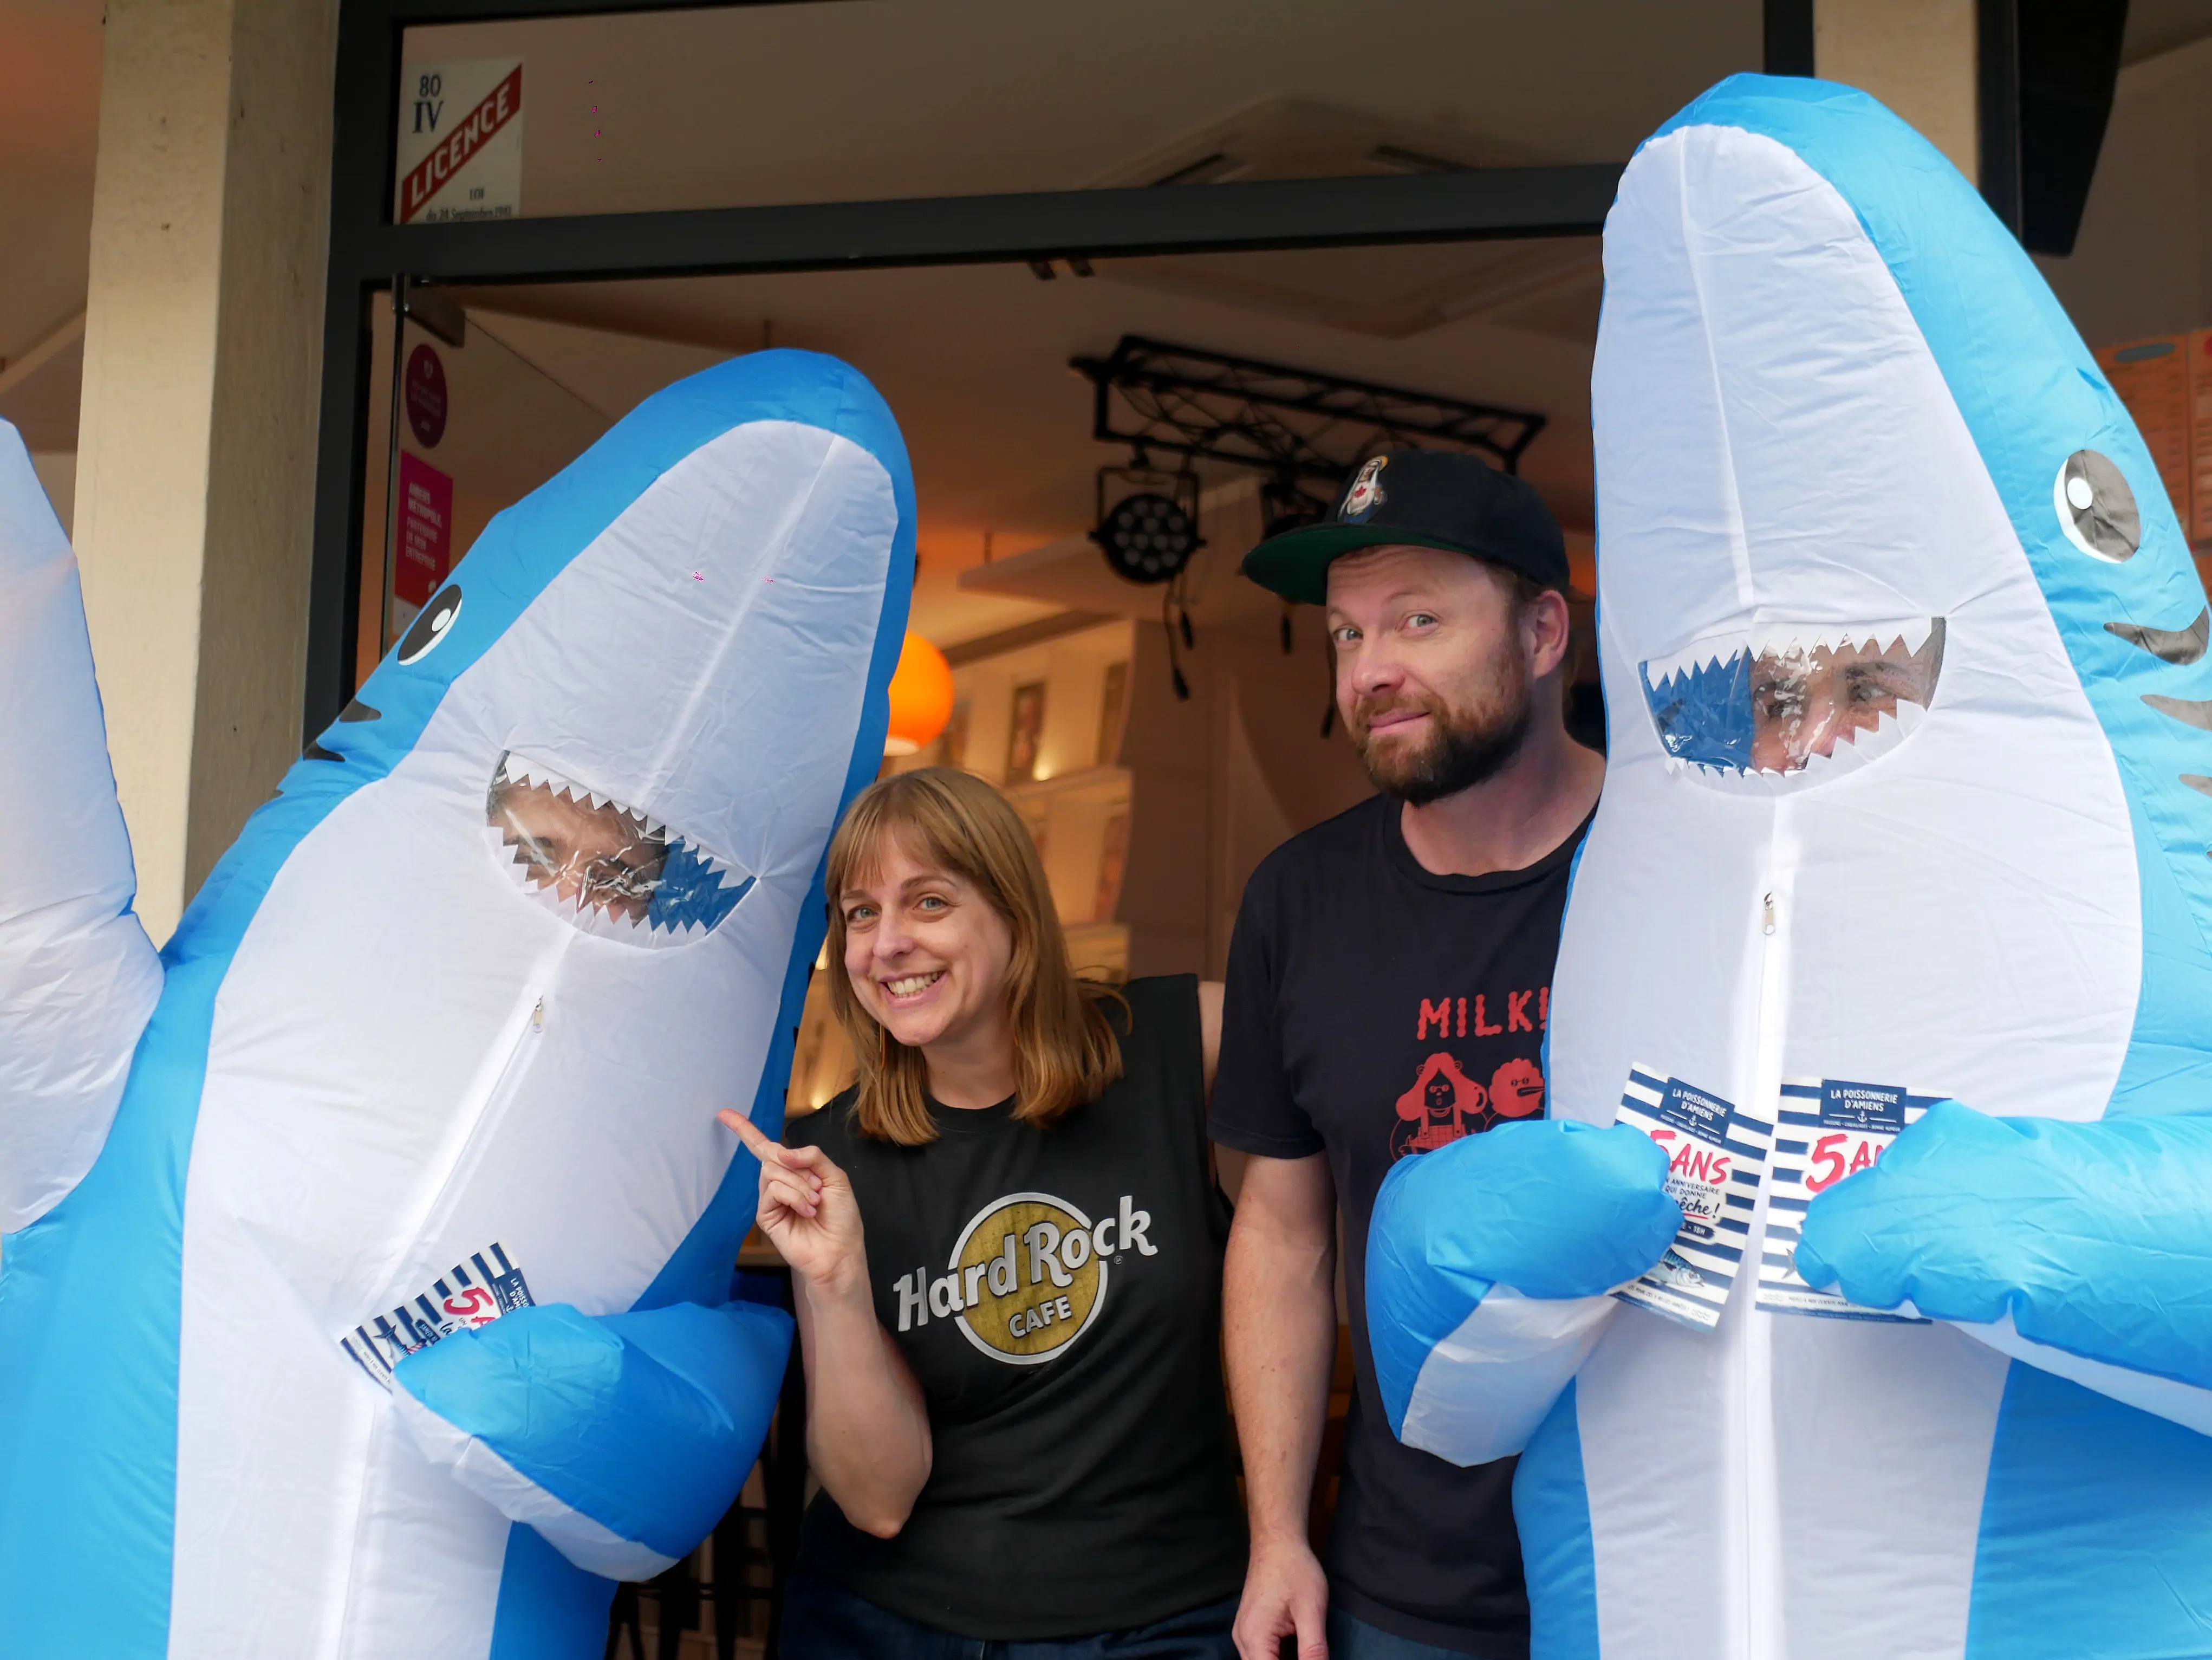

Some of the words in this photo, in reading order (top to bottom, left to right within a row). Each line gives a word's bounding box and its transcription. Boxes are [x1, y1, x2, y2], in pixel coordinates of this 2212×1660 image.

[419, 74, 441, 97] 80
[412, 100, 444, 133] IV
[411, 82, 511, 209] LICENCE
[1672, 1088, 1682, 1098] LA
[1682, 1091, 1727, 1118] POISSONNERIE
[1681, 1100, 1714, 1121] D'AMIENS
[1830, 1089, 1842, 1100] LA
[1843, 1088, 1898, 1105] POISSONNERIE
[1844, 1099, 1885, 1112] D'AMIENS
[1669, 1143, 1732, 1185] ANS
[1805, 1133, 1849, 1192] 5
[1671, 1179, 1721, 1195] ANNIVERSAIRE
[1679, 1188, 1707, 1199] DONNE
[893, 1234, 1018, 1332] Hard
[1024, 1195, 1159, 1288] Rock
[443, 1286, 495, 1316] 5
[516, 1286, 530, 1308] POISSO
[1009, 1295, 1072, 1338] CAFE
